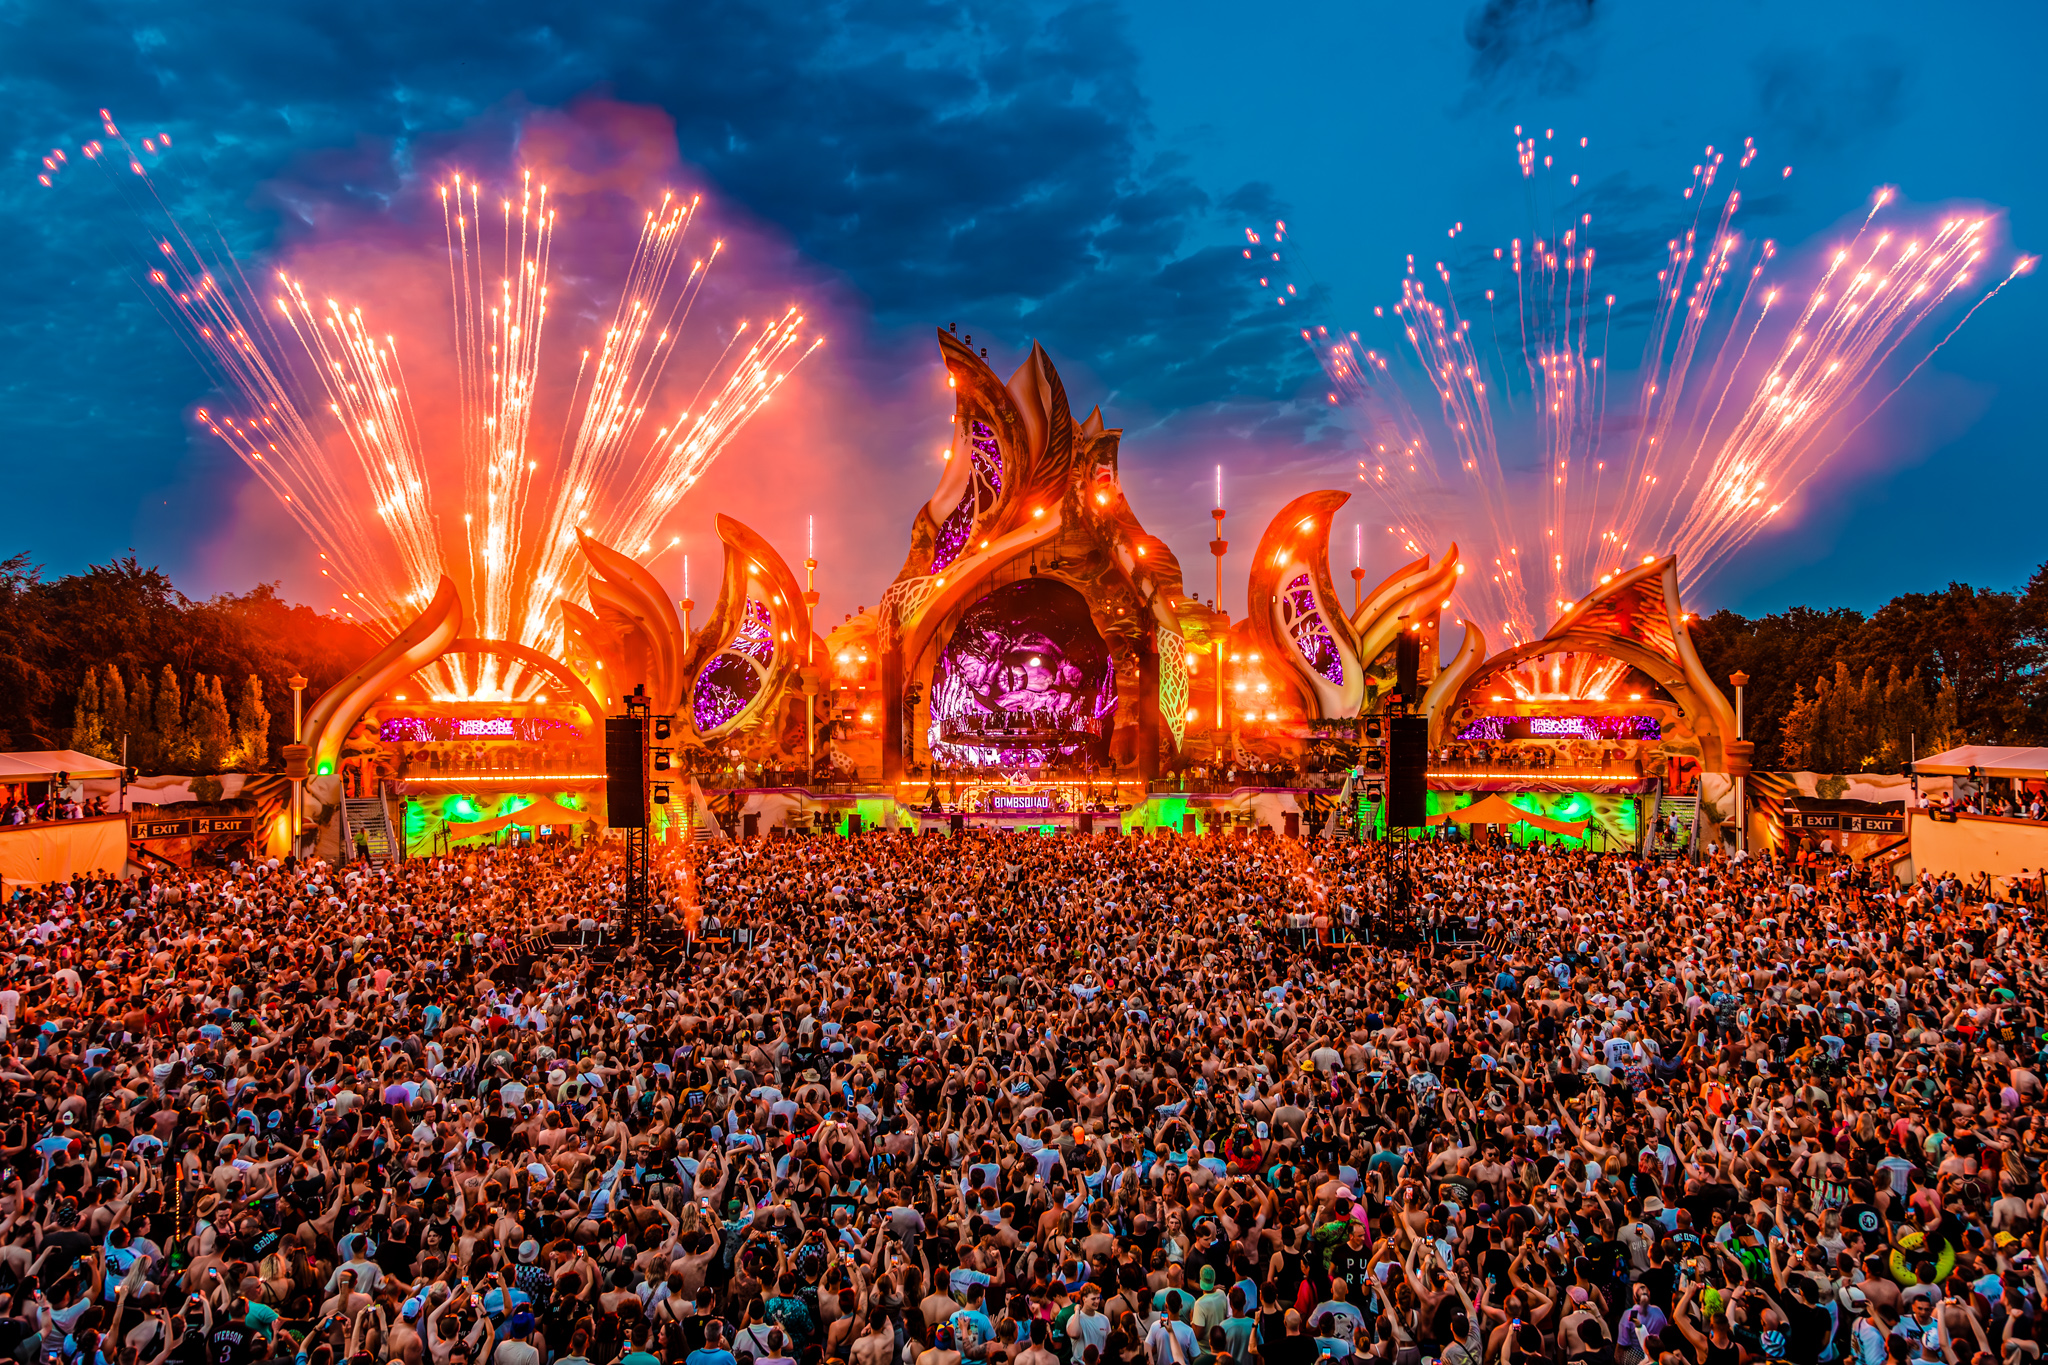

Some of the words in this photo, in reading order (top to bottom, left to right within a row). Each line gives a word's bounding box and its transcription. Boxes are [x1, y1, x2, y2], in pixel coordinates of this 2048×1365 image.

[994, 796, 1048, 808] BOMBSQUAD
[214, 821, 242, 831] EXIT
[1807, 816, 1835, 826] EXIT
[1866, 820, 1893, 830] EXIT
[152, 824, 180, 835] EXIT
[847, 1094, 854, 1107] 6
[213, 1330, 244, 1345] IVERSON
[219, 1345, 232, 1363] 3
